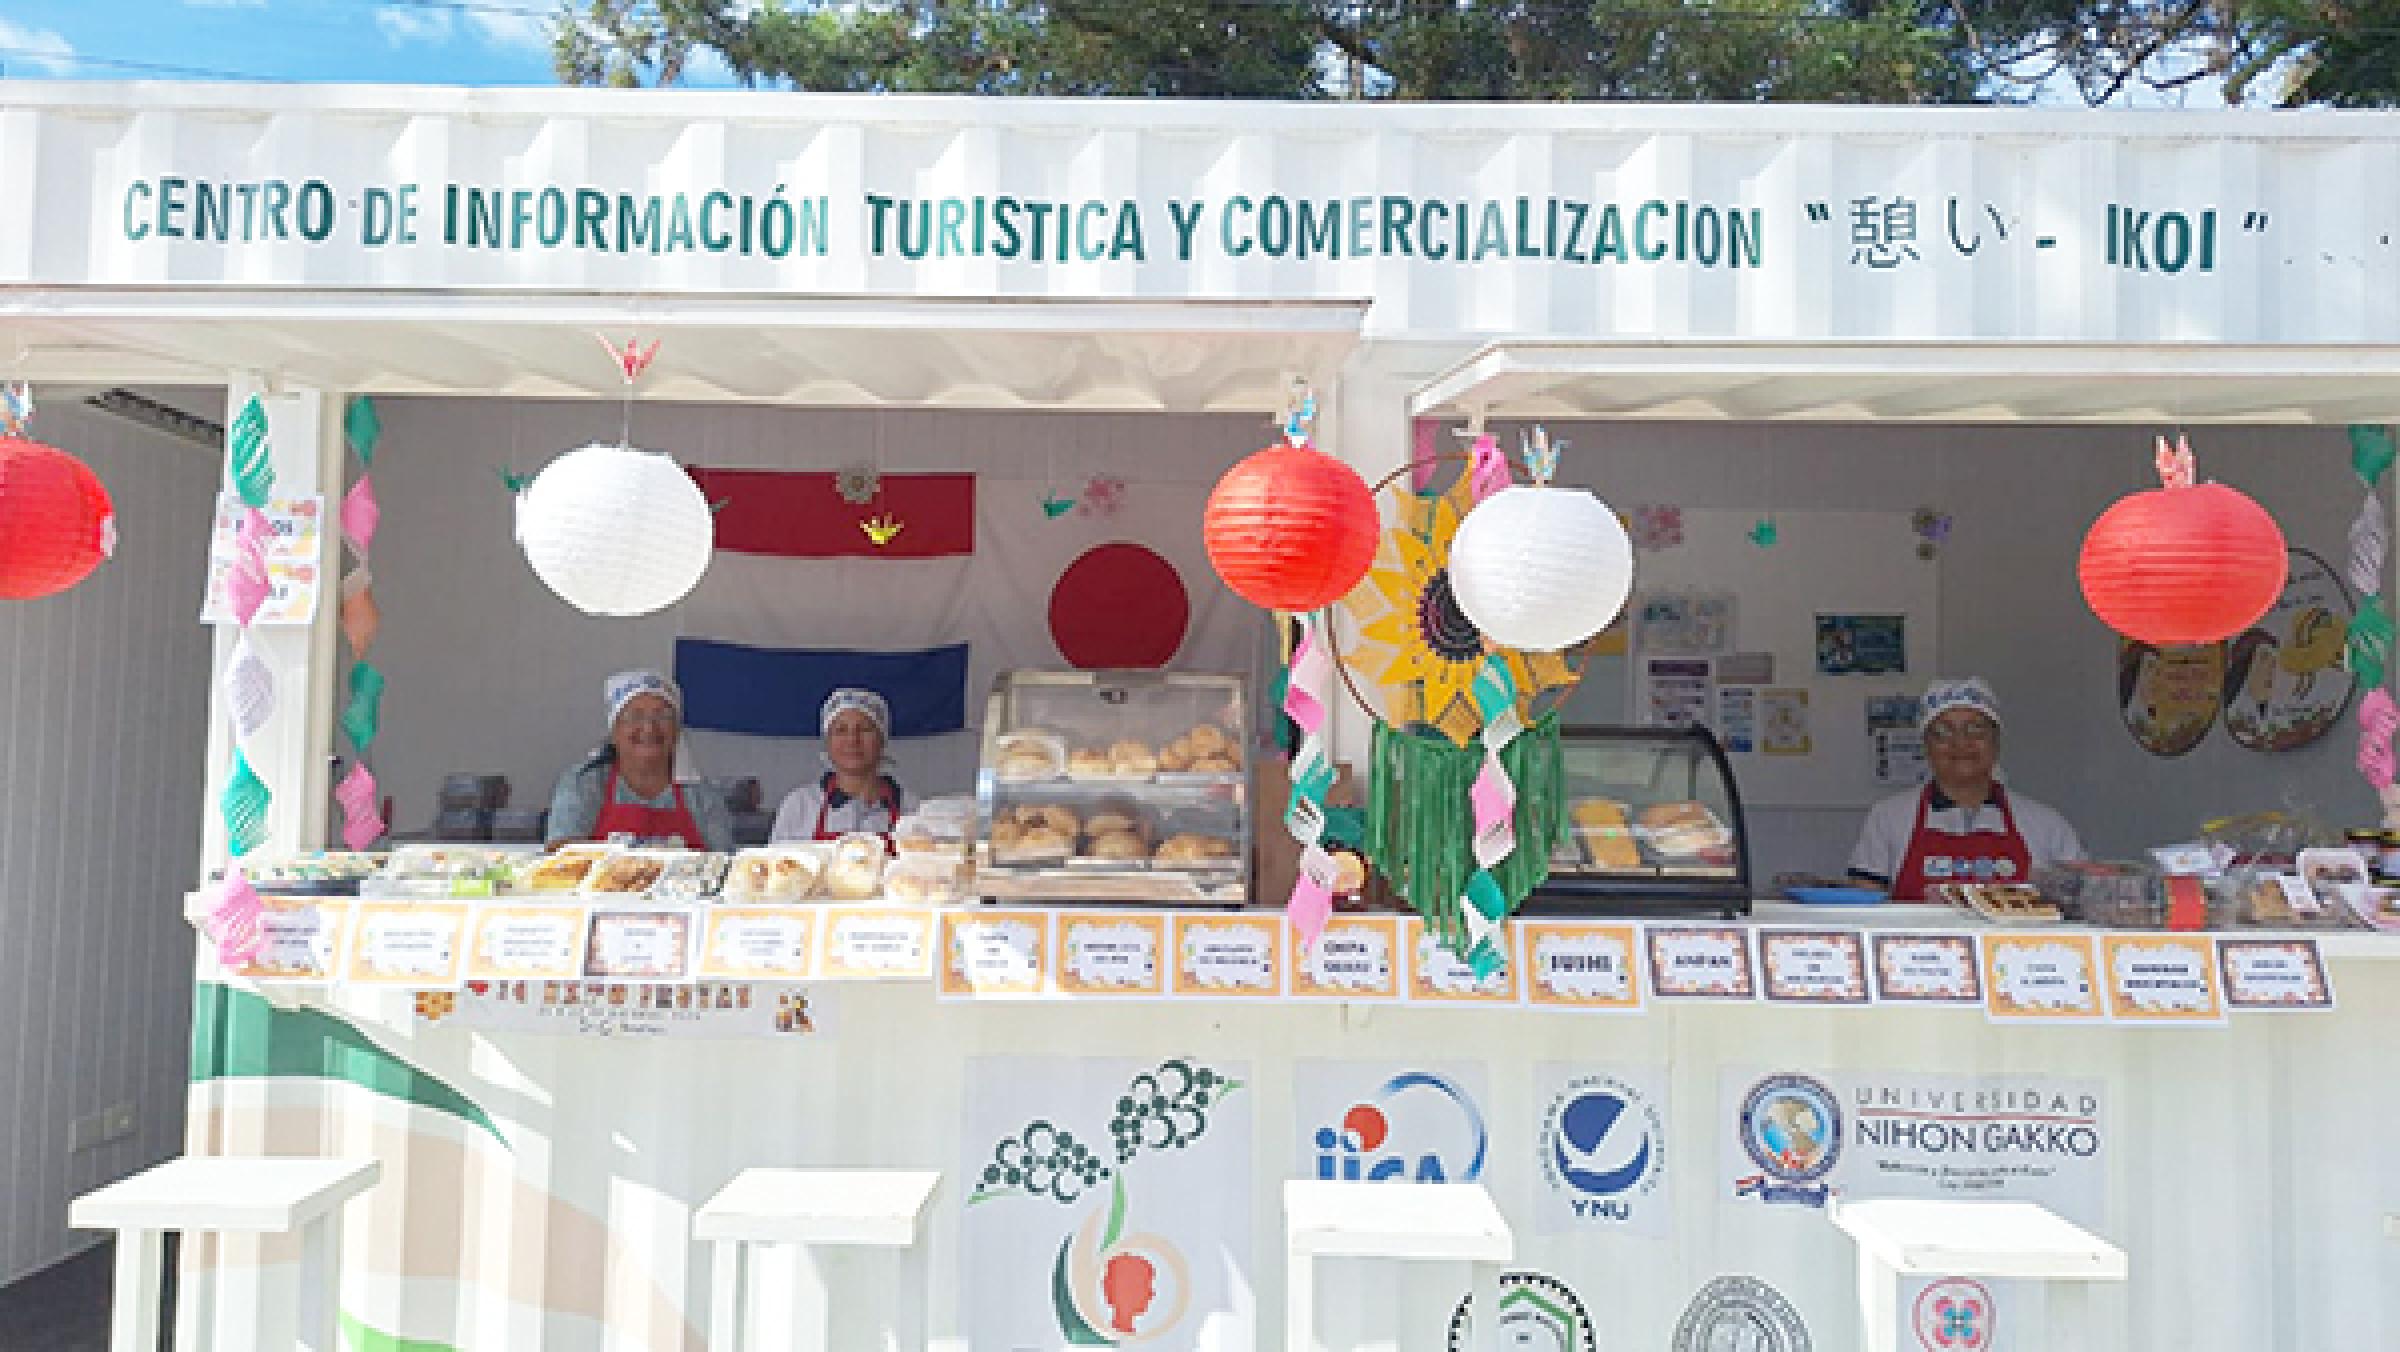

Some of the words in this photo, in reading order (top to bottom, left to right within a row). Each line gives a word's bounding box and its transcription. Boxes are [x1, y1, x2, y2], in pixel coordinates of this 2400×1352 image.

[122, 176, 334, 241] CENTRO
[363, 184, 418, 246] DE
[443, 184, 829, 260] INFORMACIÓN
[864, 195, 1146, 264] TURISTICA
[1168, 199, 1205, 262] Y
[1221, 195, 1764, 268] COMERCIALIZACION
[1855, 1086, 2098, 1117] UNIVERSIDAD
[1855, 1119, 1978, 1155] NIHON
[1983, 1120, 2100, 1158] GAKKO
[1572, 1200, 1629, 1221] YNU
